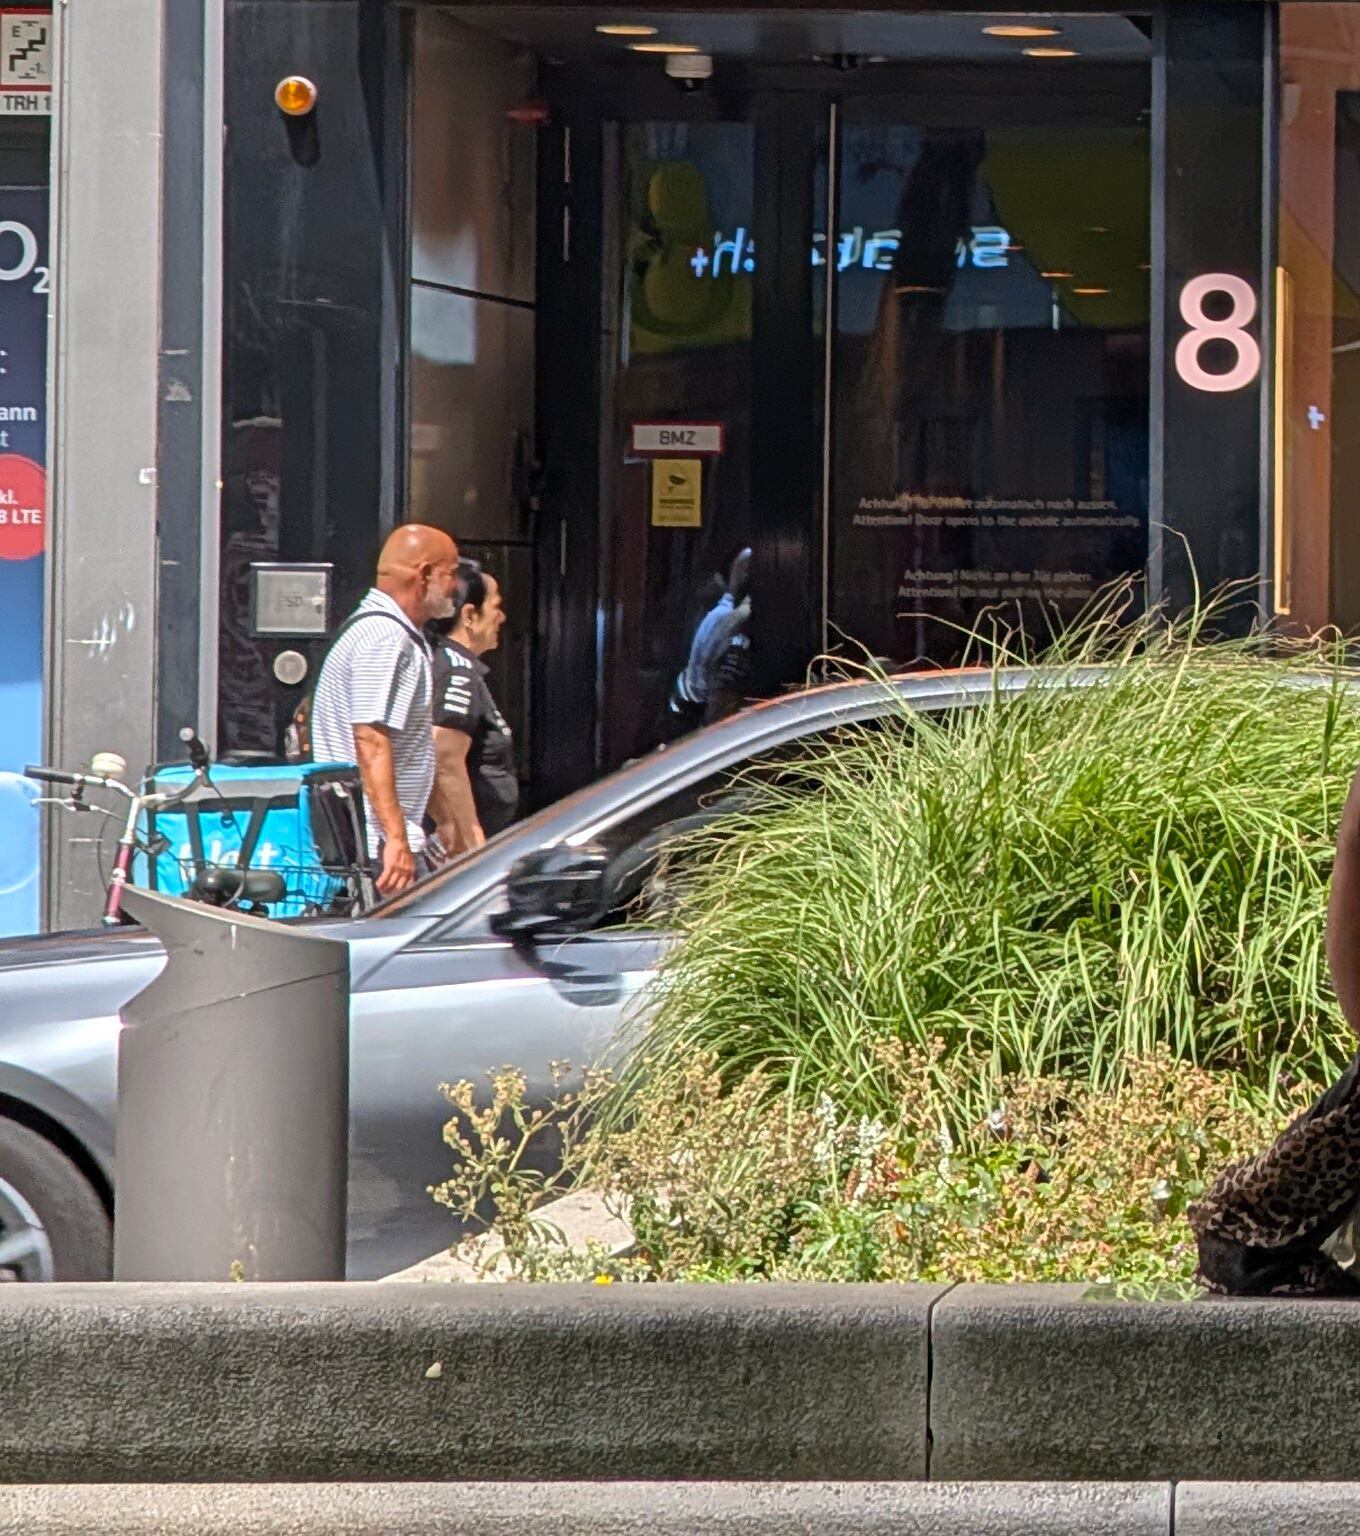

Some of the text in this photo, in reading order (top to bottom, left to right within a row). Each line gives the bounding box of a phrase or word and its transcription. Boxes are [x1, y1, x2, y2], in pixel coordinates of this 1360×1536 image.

[4, 94, 38, 112] TRH
[1175, 272, 1261, 392] 8
[659, 430, 697, 446] BMZ
[12, 509, 42, 525] LTE
